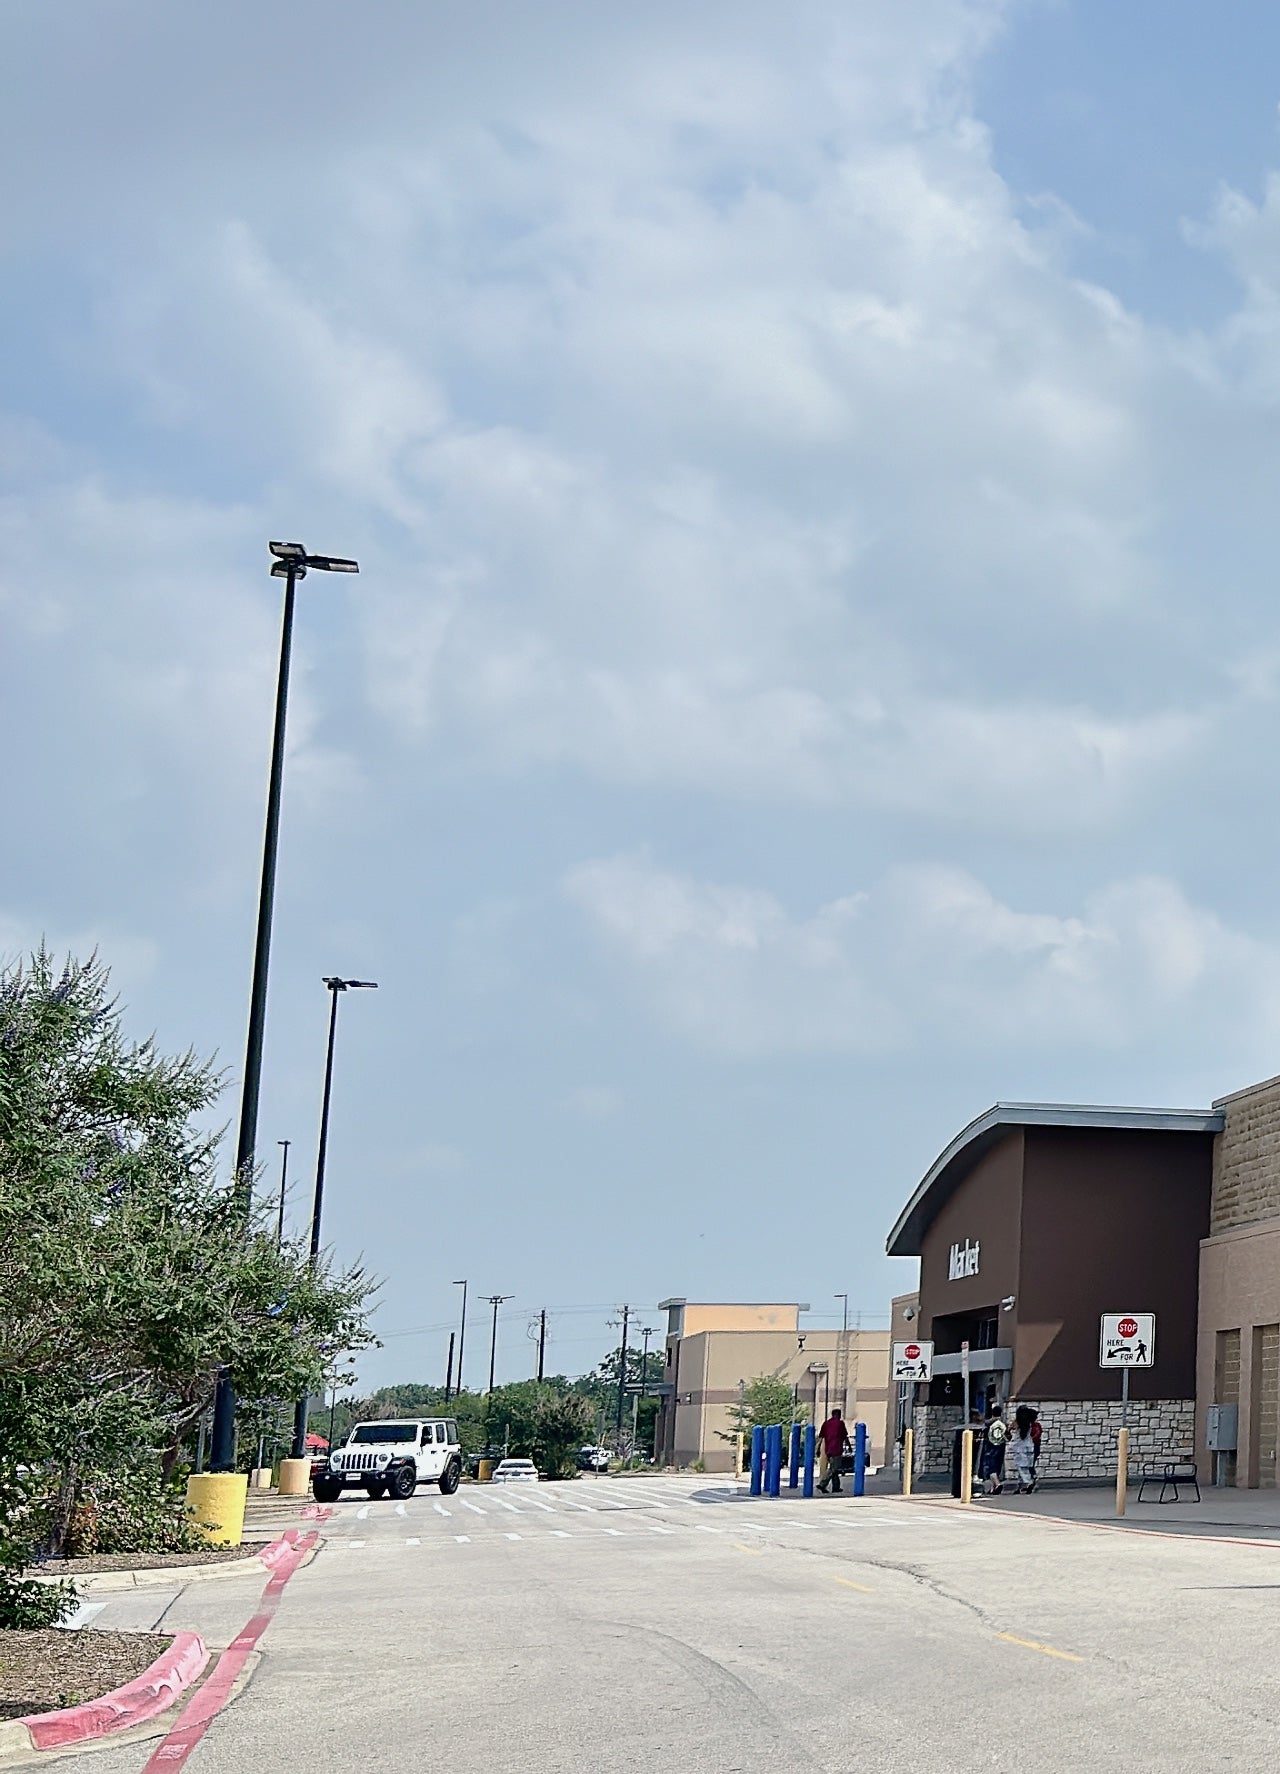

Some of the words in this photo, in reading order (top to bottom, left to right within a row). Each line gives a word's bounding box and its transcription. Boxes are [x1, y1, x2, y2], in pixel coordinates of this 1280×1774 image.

[948, 1238, 980, 1281] Market
[1119, 1323, 1138, 1333] STOP
[1106, 1339, 1125, 1347] HERE
[1120, 1353, 1134, 1361] FOR
